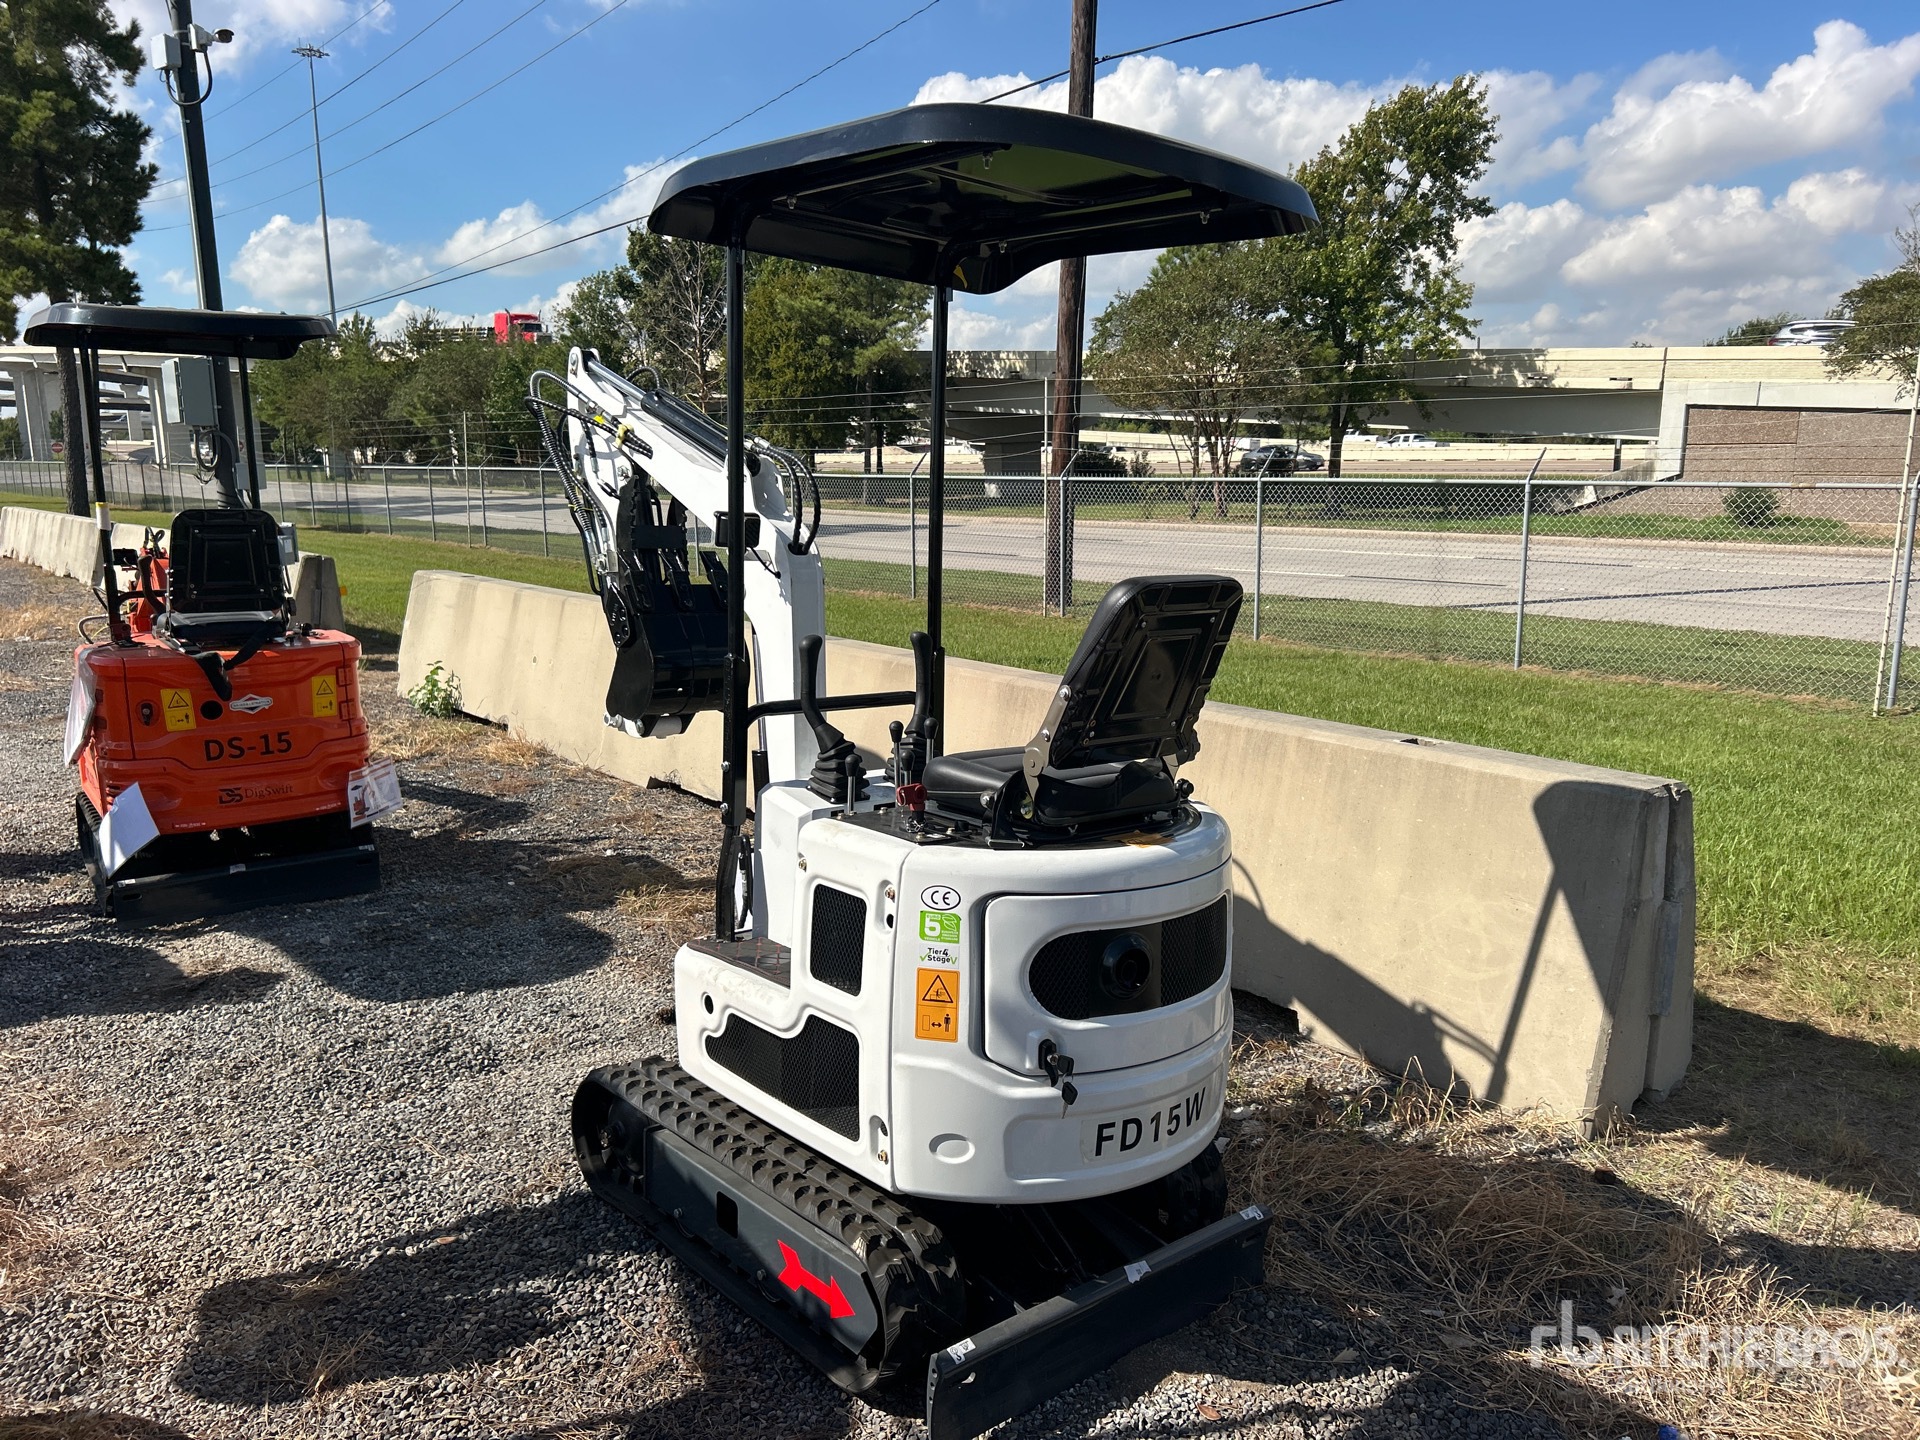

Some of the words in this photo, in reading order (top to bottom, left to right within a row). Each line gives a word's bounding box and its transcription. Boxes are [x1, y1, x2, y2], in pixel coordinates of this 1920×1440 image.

[204, 731, 292, 762] DS-15
[244, 784, 293, 799] DigSwift
[930, 890, 951, 906] CE
[927, 947, 942, 955] Tier
[942, 948, 949, 957] 4
[1095, 1087, 1206, 1157] FD15W
